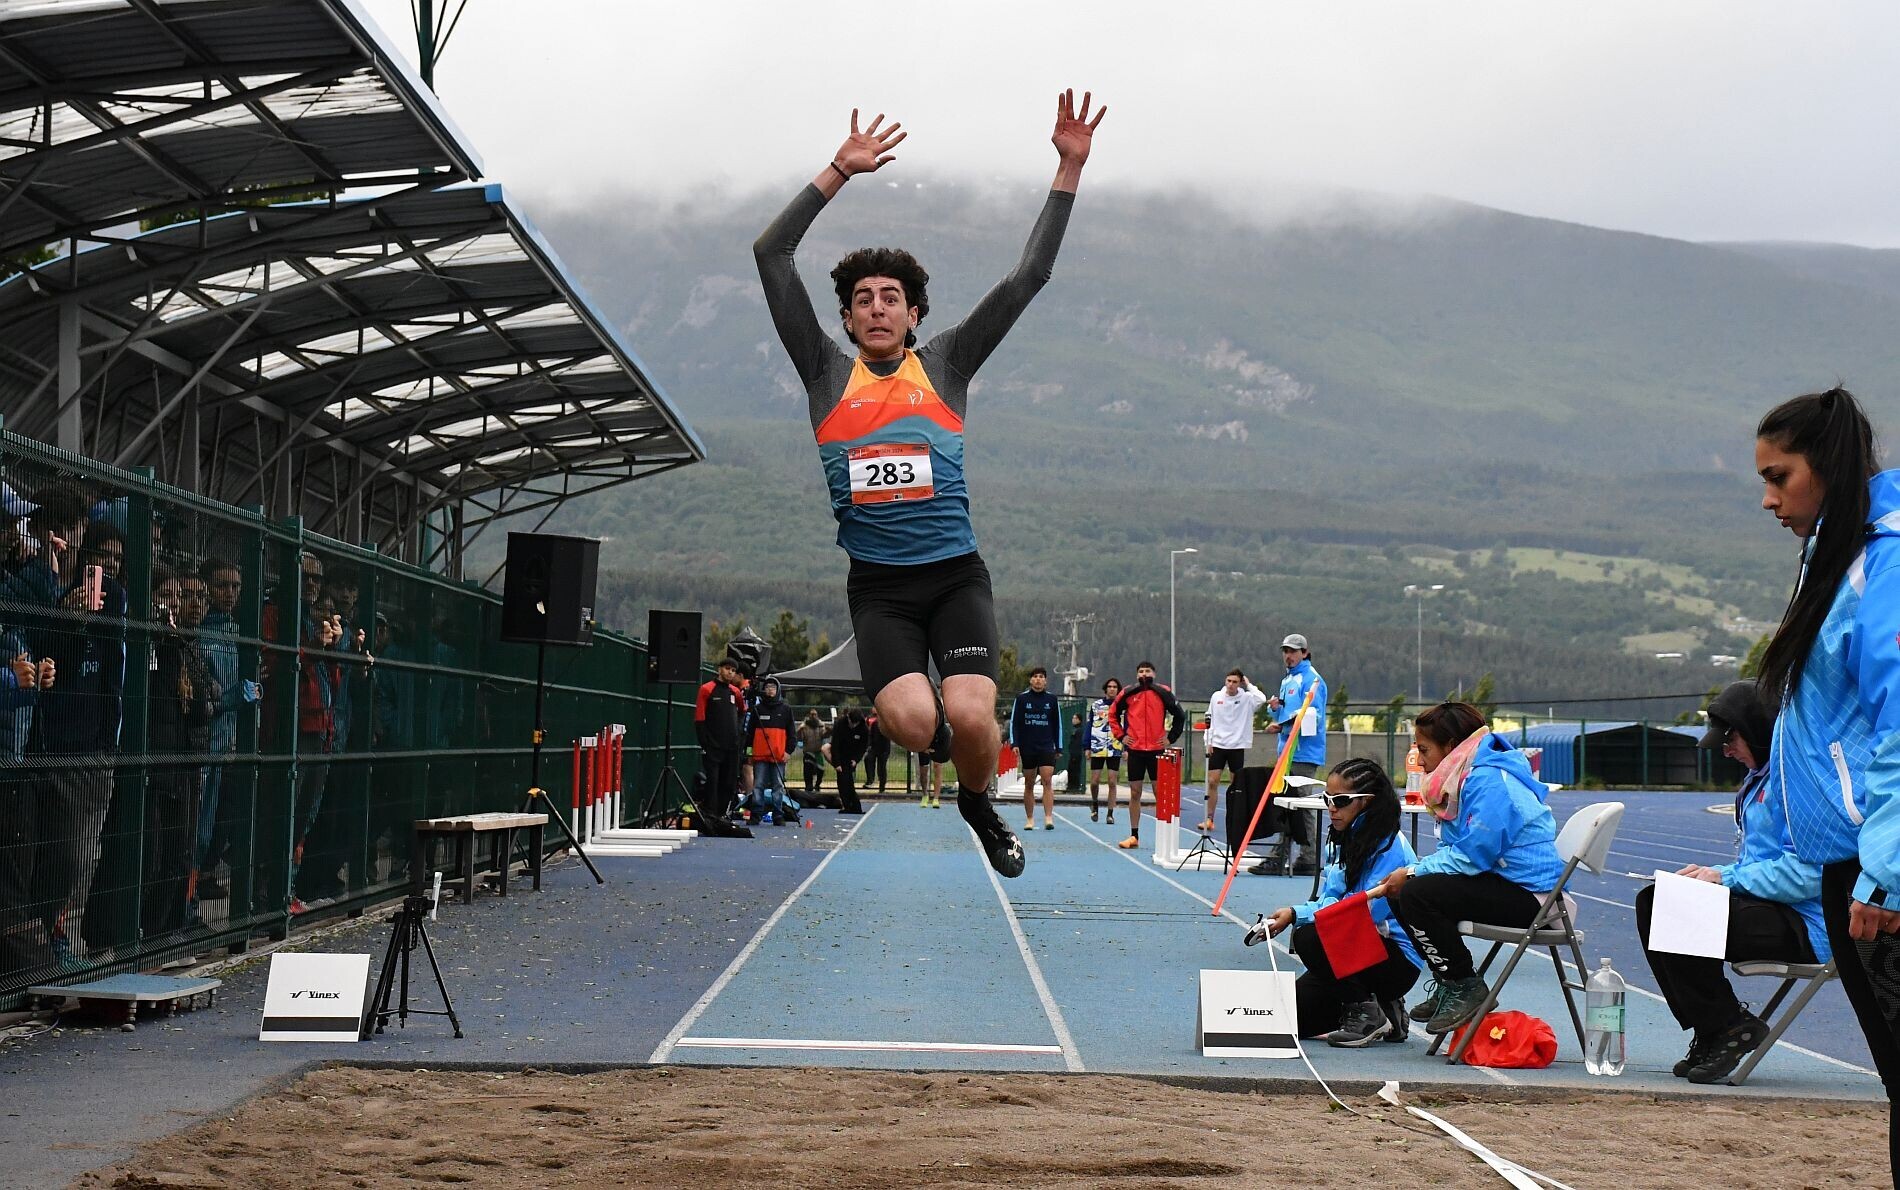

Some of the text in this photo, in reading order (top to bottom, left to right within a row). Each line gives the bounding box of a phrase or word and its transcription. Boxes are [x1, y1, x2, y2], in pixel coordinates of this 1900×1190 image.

[865, 462, 915, 486] 283
[953, 651, 989, 659] DEPORTES
[308, 990, 340, 999] Vinex
[1242, 1007, 1274, 1015] Vinex
